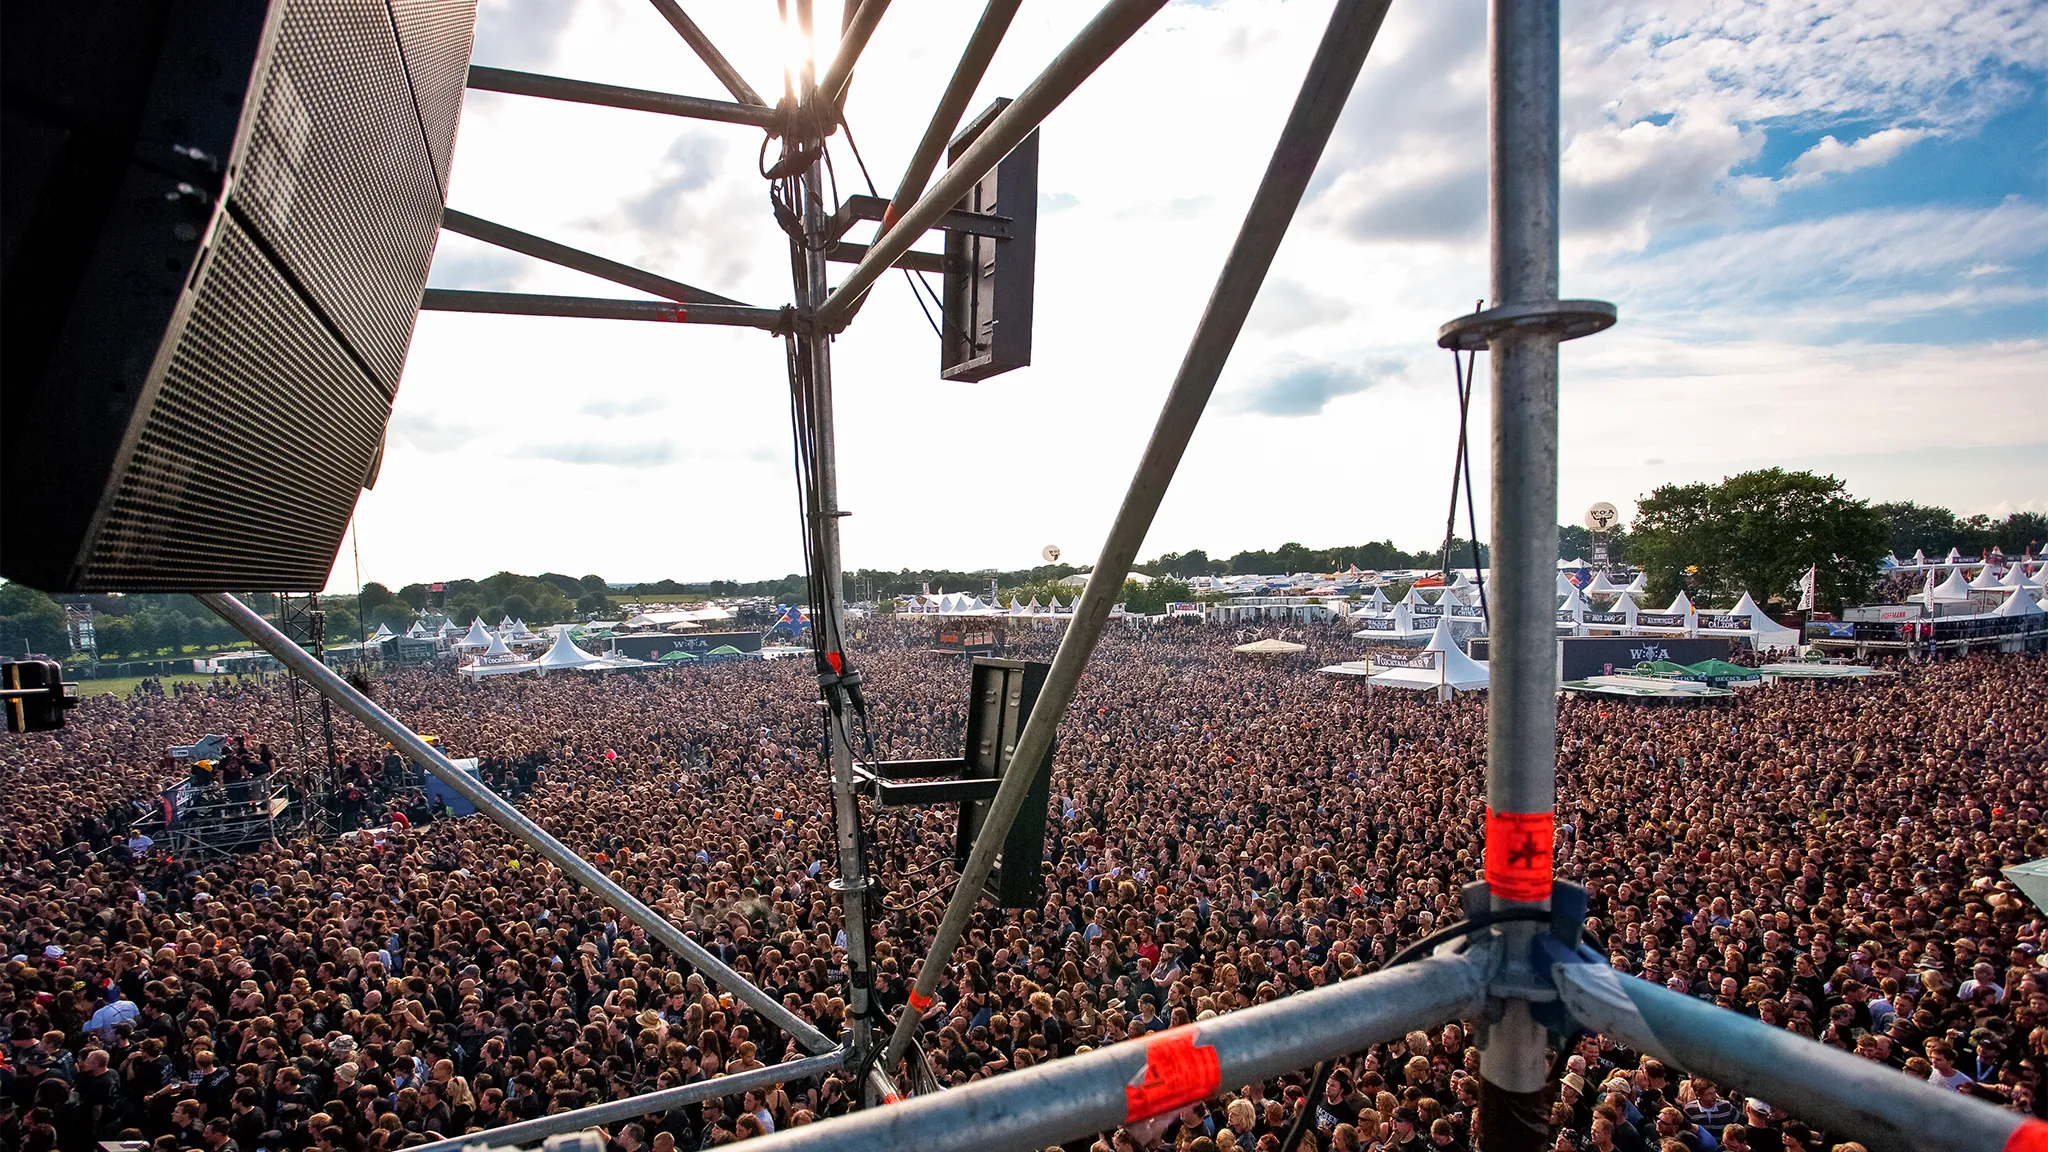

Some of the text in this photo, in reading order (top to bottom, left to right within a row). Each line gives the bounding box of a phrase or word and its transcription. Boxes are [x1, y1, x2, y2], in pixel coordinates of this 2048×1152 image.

[1708, 621, 1740, 629] CALZONE
[1381, 658, 1424, 668] COCKTAIL BAR
